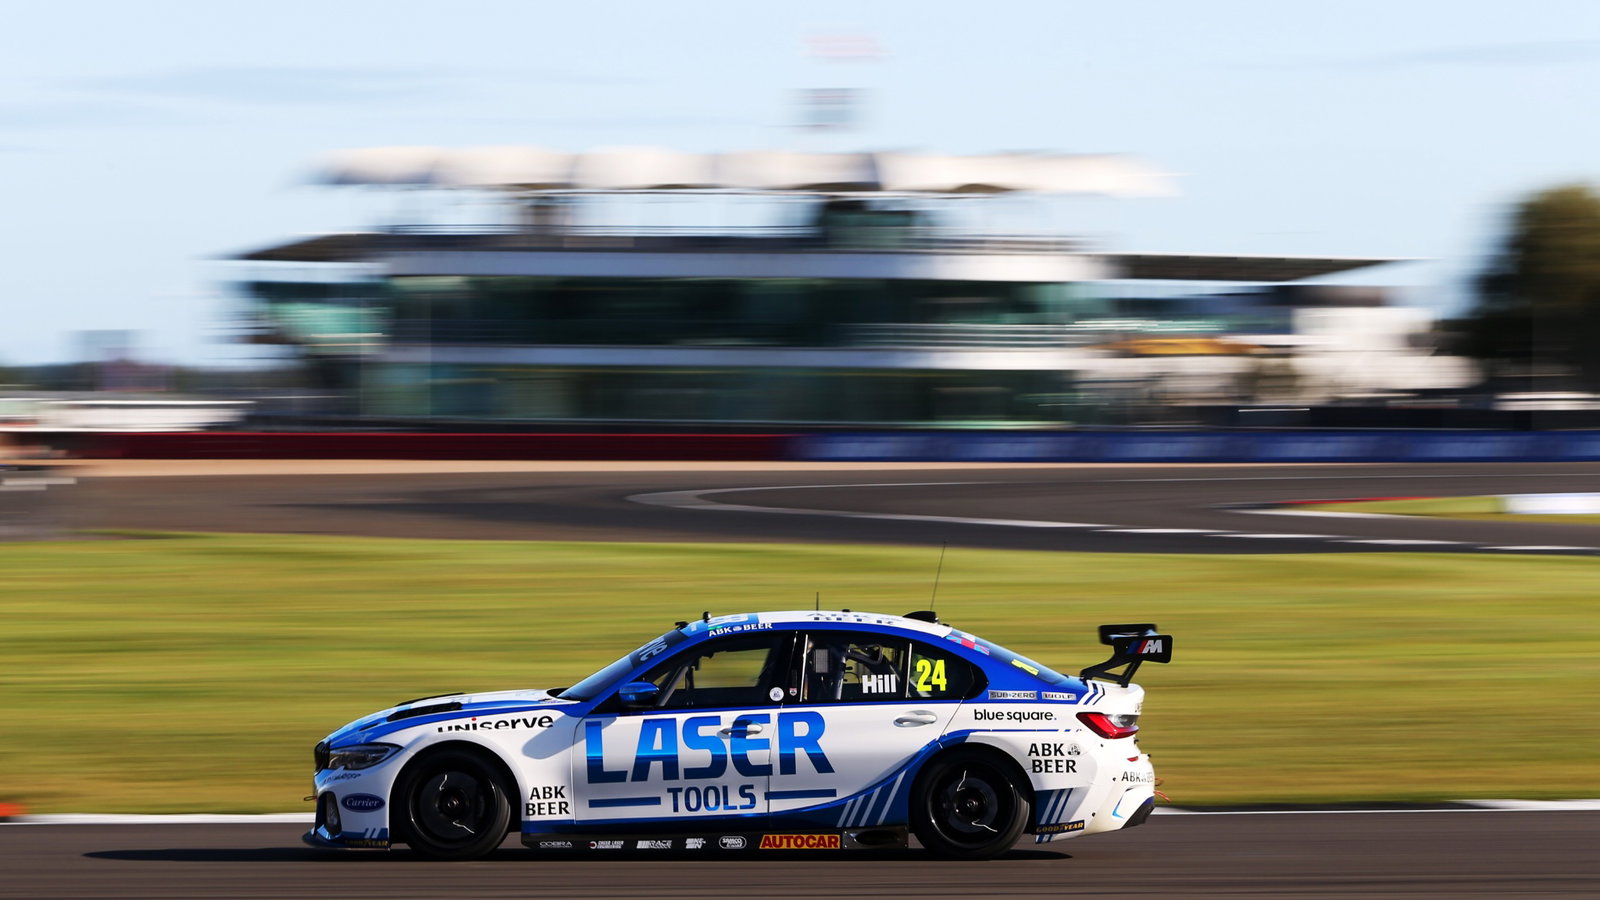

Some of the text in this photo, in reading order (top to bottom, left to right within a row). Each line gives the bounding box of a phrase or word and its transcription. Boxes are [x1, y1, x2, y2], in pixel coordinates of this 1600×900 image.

[708, 622, 773, 637] ABK BEER
[916, 659, 947, 692] 24
[862, 674, 897, 694] Hill
[974, 709, 1057, 723] blue square.
[585, 711, 836, 784] LASER
[1027, 743, 1065, 757] ABK
[1031, 759, 1078, 774] BEER
[530, 785, 566, 800] ABK
[666, 784, 757, 813] TOOLS
[345, 797, 380, 808] Carrier
[525, 801, 570, 816] BEER
[761, 835, 839, 848] AUTOCAR
